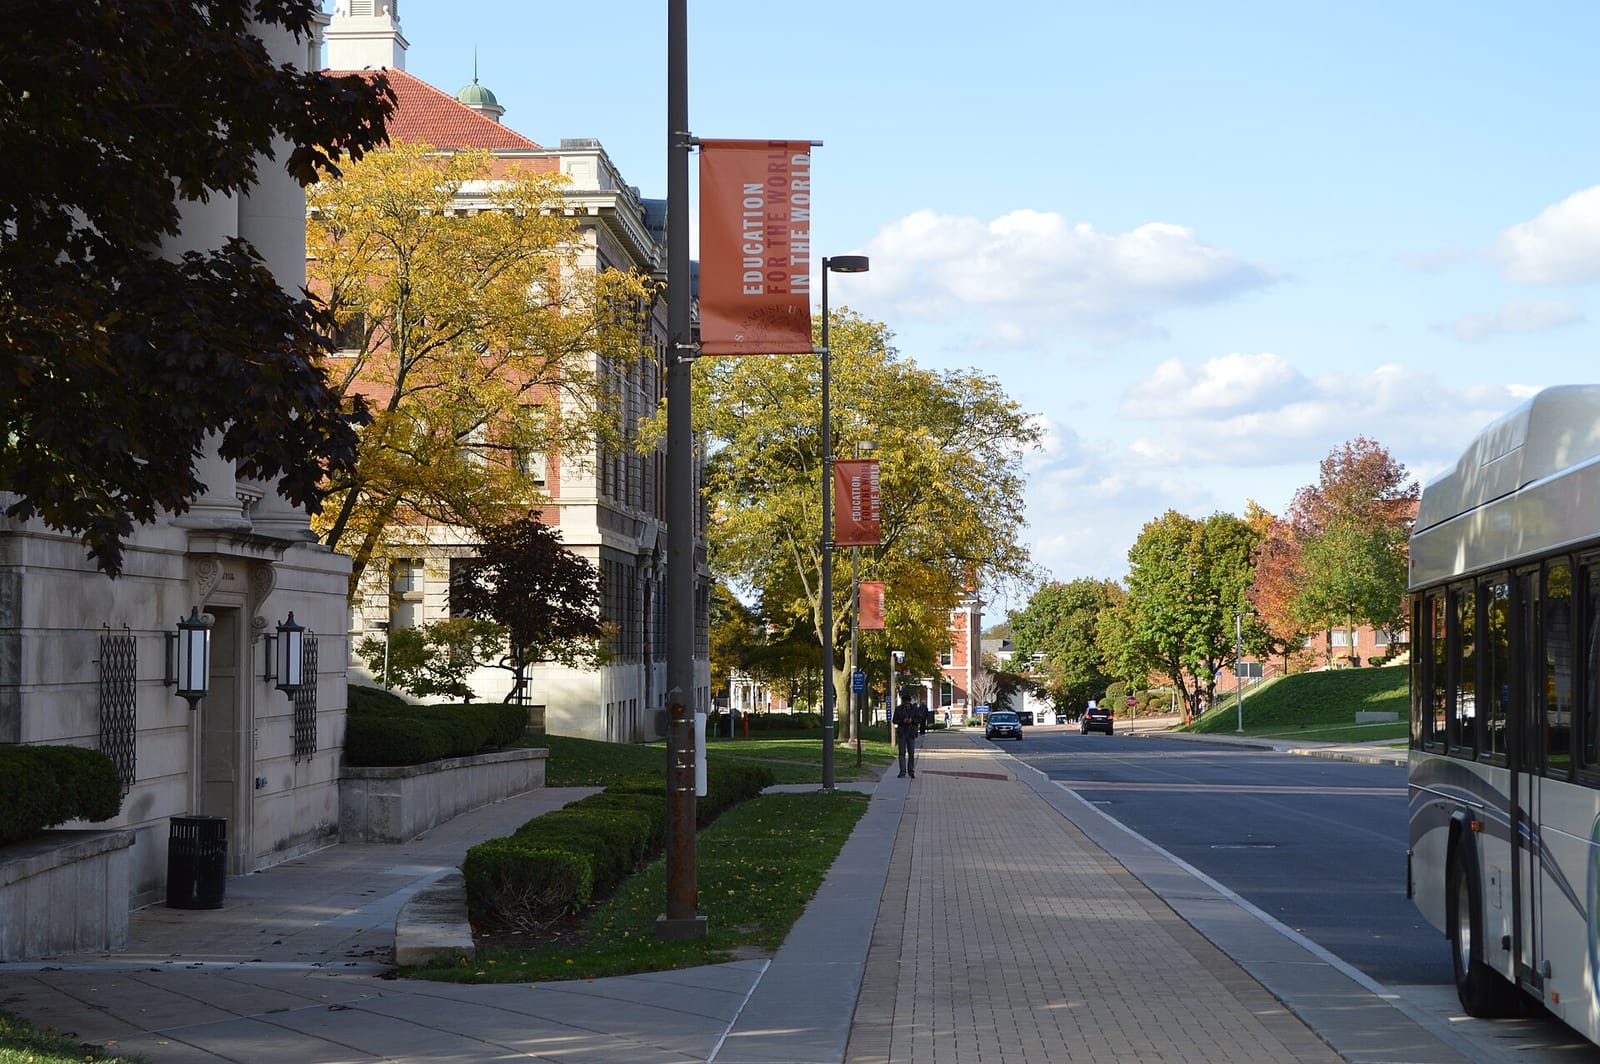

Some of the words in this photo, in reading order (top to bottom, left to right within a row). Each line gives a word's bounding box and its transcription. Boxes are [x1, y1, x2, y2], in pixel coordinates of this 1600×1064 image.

[790, 153, 810, 223] WORLD
[743, 183, 764, 296] EDUCATION
[766, 212, 788, 249] THE
[790, 229, 810, 266] THE
[766, 256, 787, 295] FOR
[790, 273, 810, 295] IN
[871, 464, 880, 493] WORLD
[852, 477, 861, 521] EDUCATION
[871, 494, 880, 510] THE
[871, 512, 880, 521] IN
